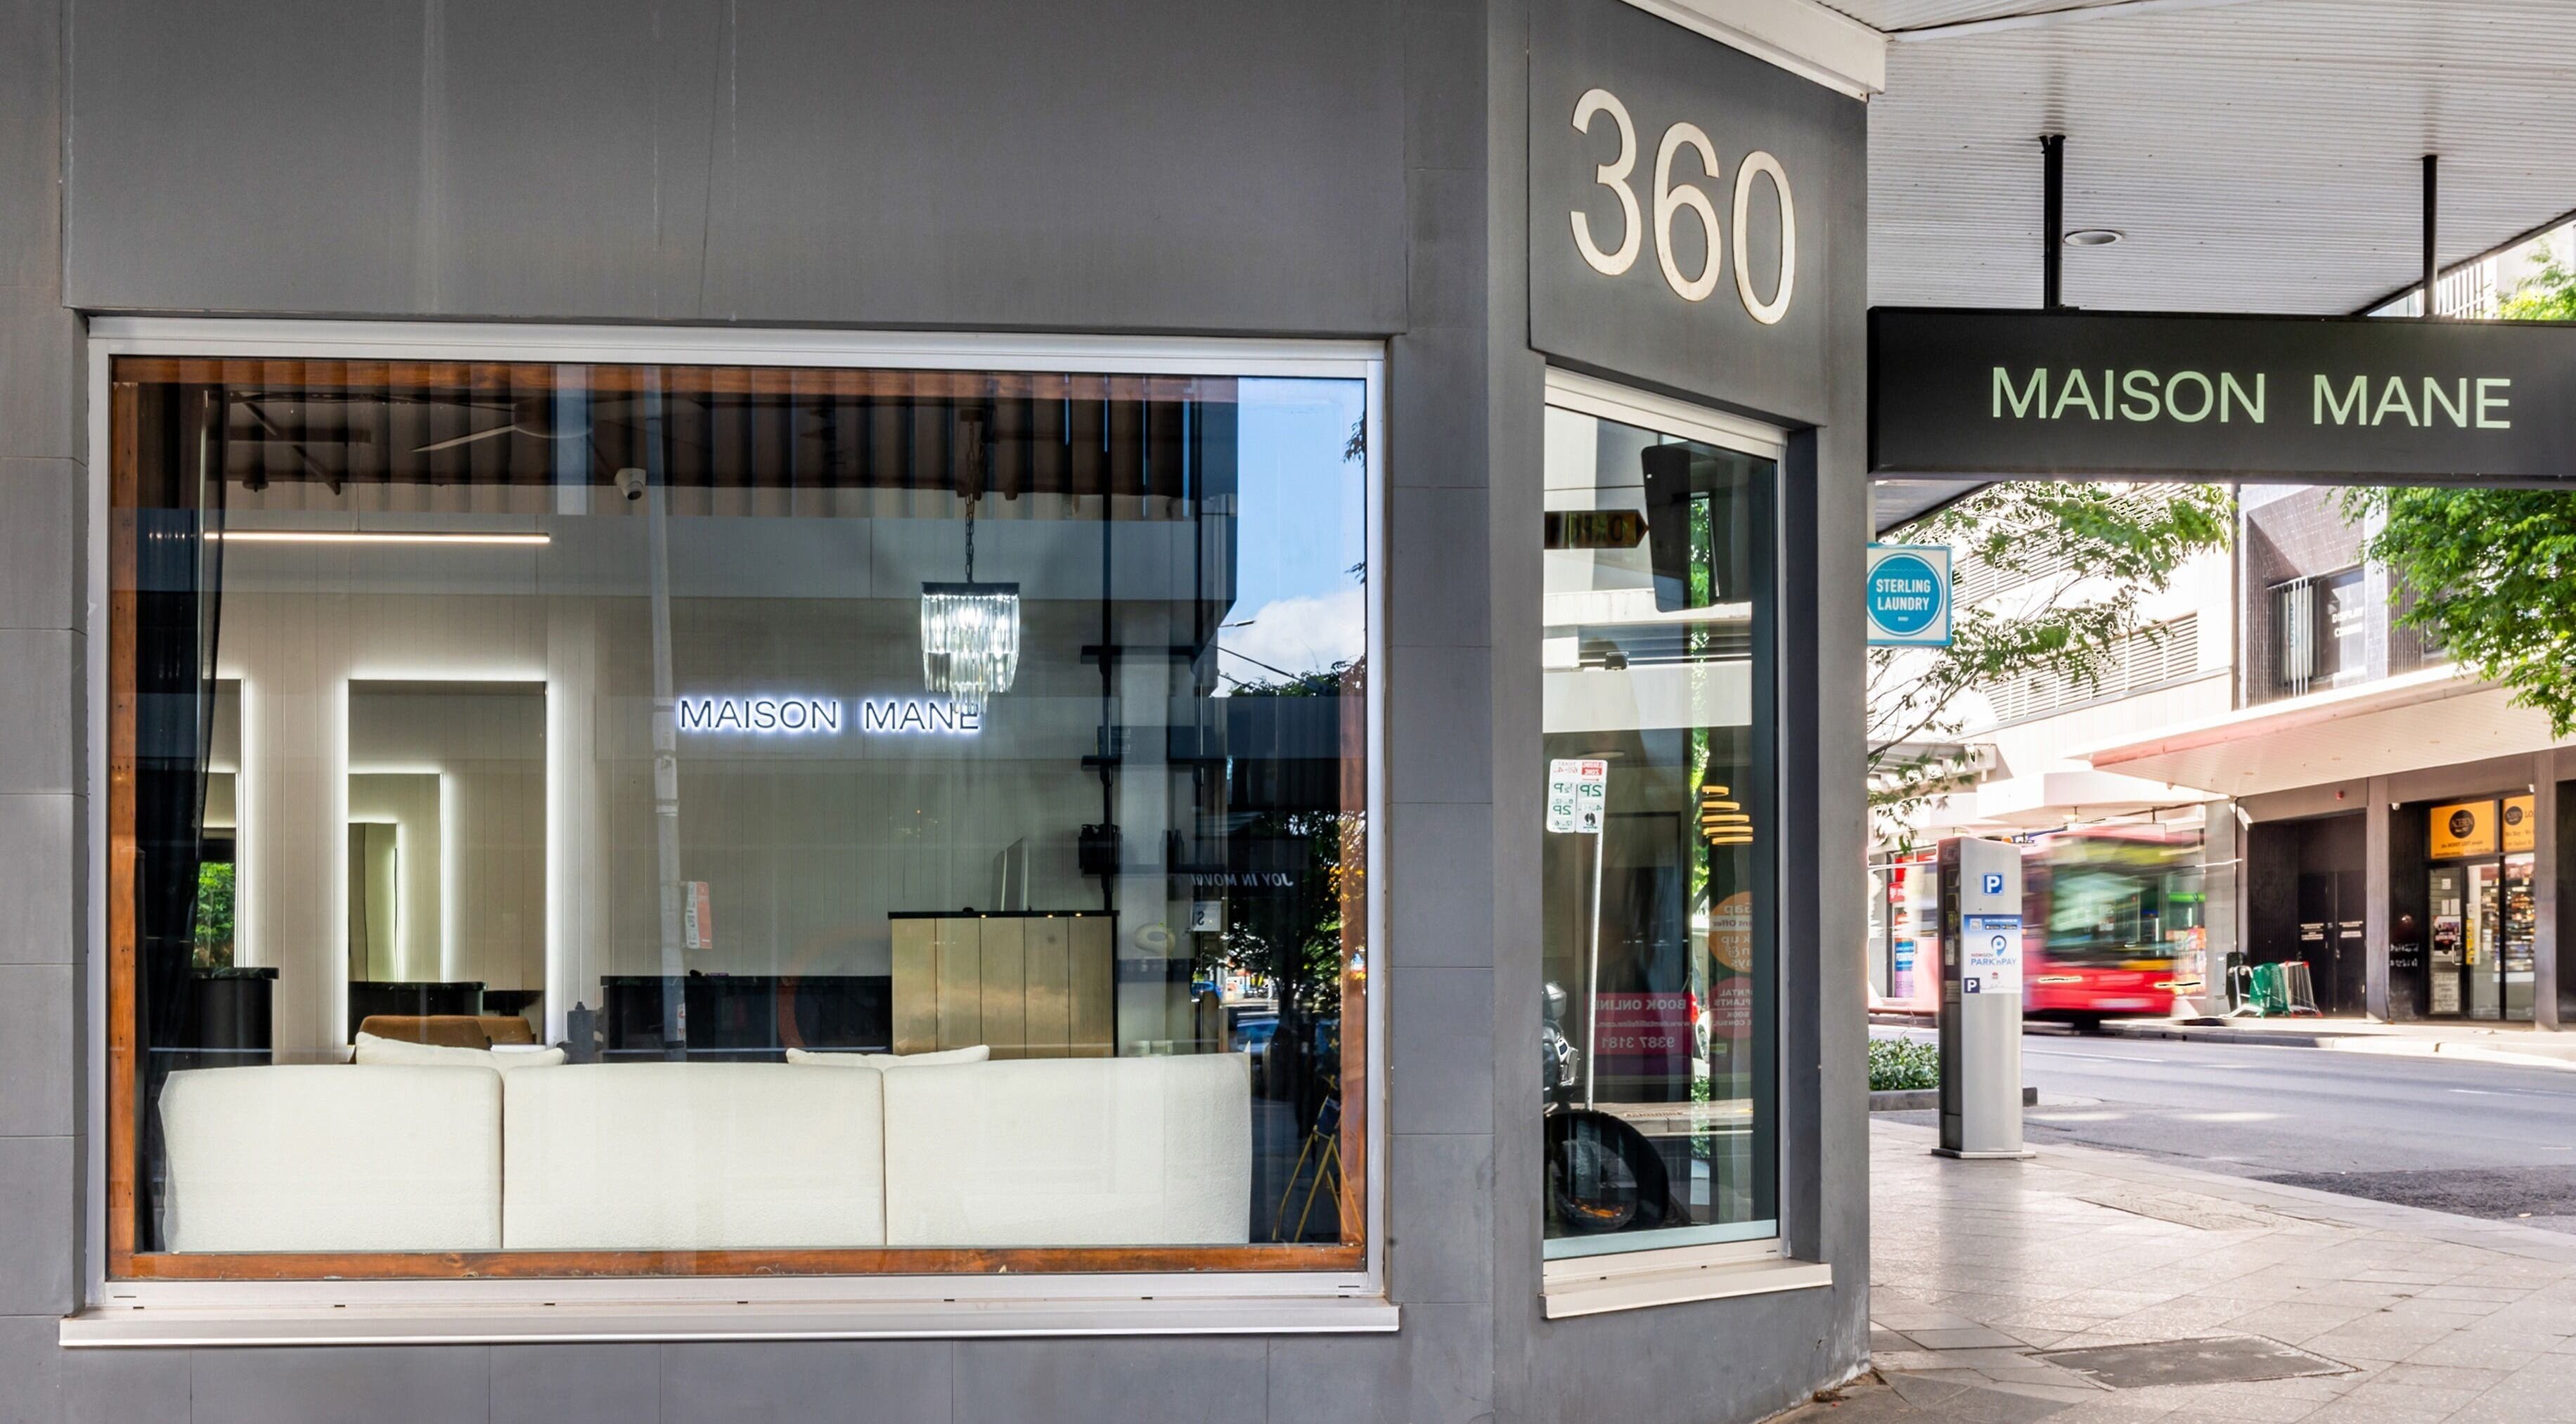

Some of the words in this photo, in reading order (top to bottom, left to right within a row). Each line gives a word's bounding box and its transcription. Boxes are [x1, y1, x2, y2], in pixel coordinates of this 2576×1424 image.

[1571, 88, 1796, 325] 360
[1992, 367, 2265, 423] MAISON
[2314, 374, 2511, 429] MANE
[1876, 578, 1931, 593] STERLING
[1877, 597, 1930, 611] LAUNDRY
[681, 700, 837, 728] MAISON
[865, 701, 979, 730] MANE
[1987, 876, 2000, 893] P
[1967, 979, 1977, 992] P
